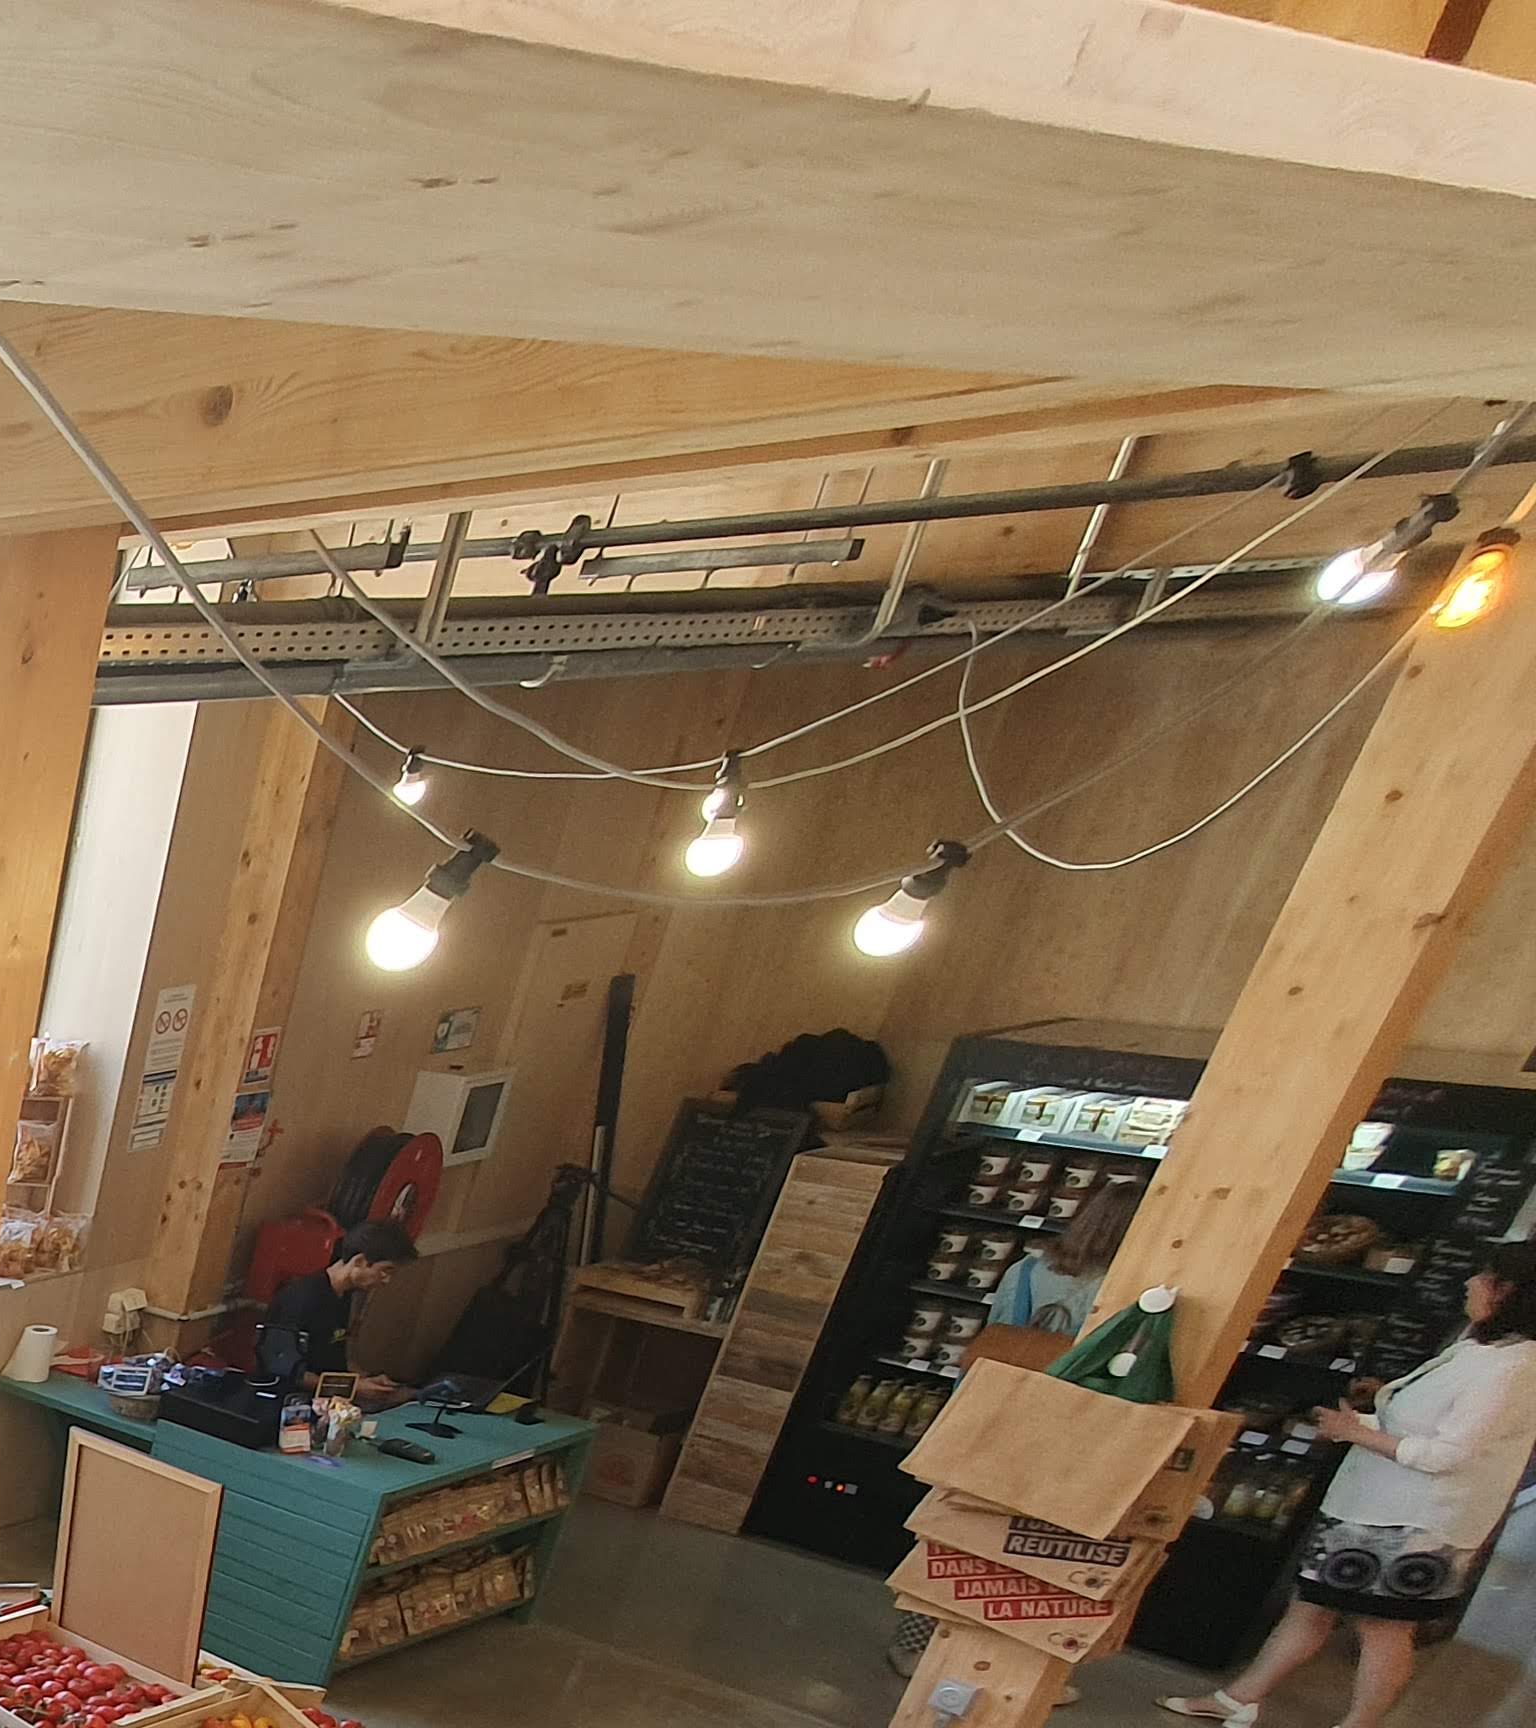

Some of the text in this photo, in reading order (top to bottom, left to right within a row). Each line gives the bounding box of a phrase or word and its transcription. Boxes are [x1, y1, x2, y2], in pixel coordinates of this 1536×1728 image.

[1008, 1535, 1125, 1565] REUTILISE
[931, 1559, 987, 1576] DANS
[958, 1579, 1042, 1598] JAMAIS
[988, 1599, 1108, 1619] LA NATURE
